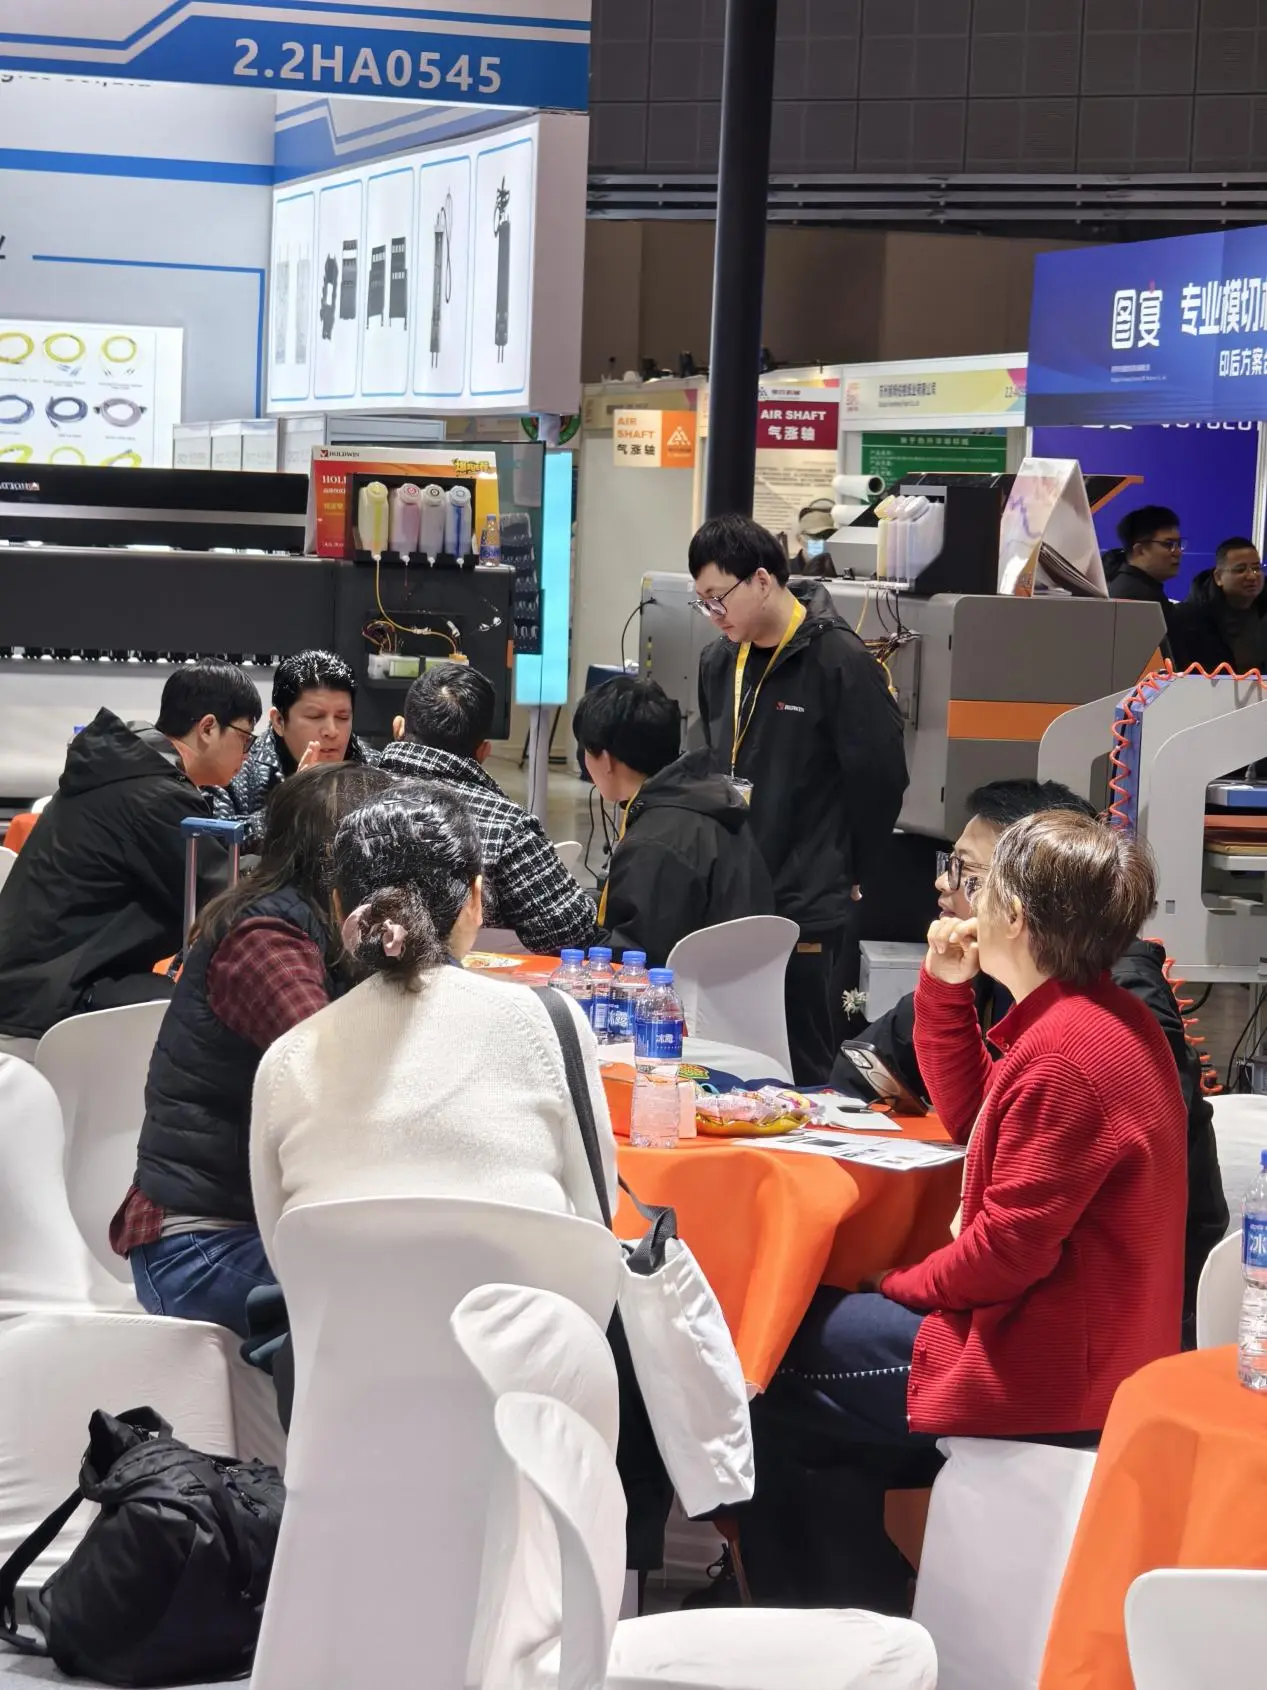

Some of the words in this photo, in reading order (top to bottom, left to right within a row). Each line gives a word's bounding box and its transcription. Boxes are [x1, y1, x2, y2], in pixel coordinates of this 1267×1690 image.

[233, 38, 501, 94] 2.2HA0545
[761, 409, 782, 420] AIR
[785, 410, 826, 421] SHAFT
[617, 430, 655, 439] SHAFT
